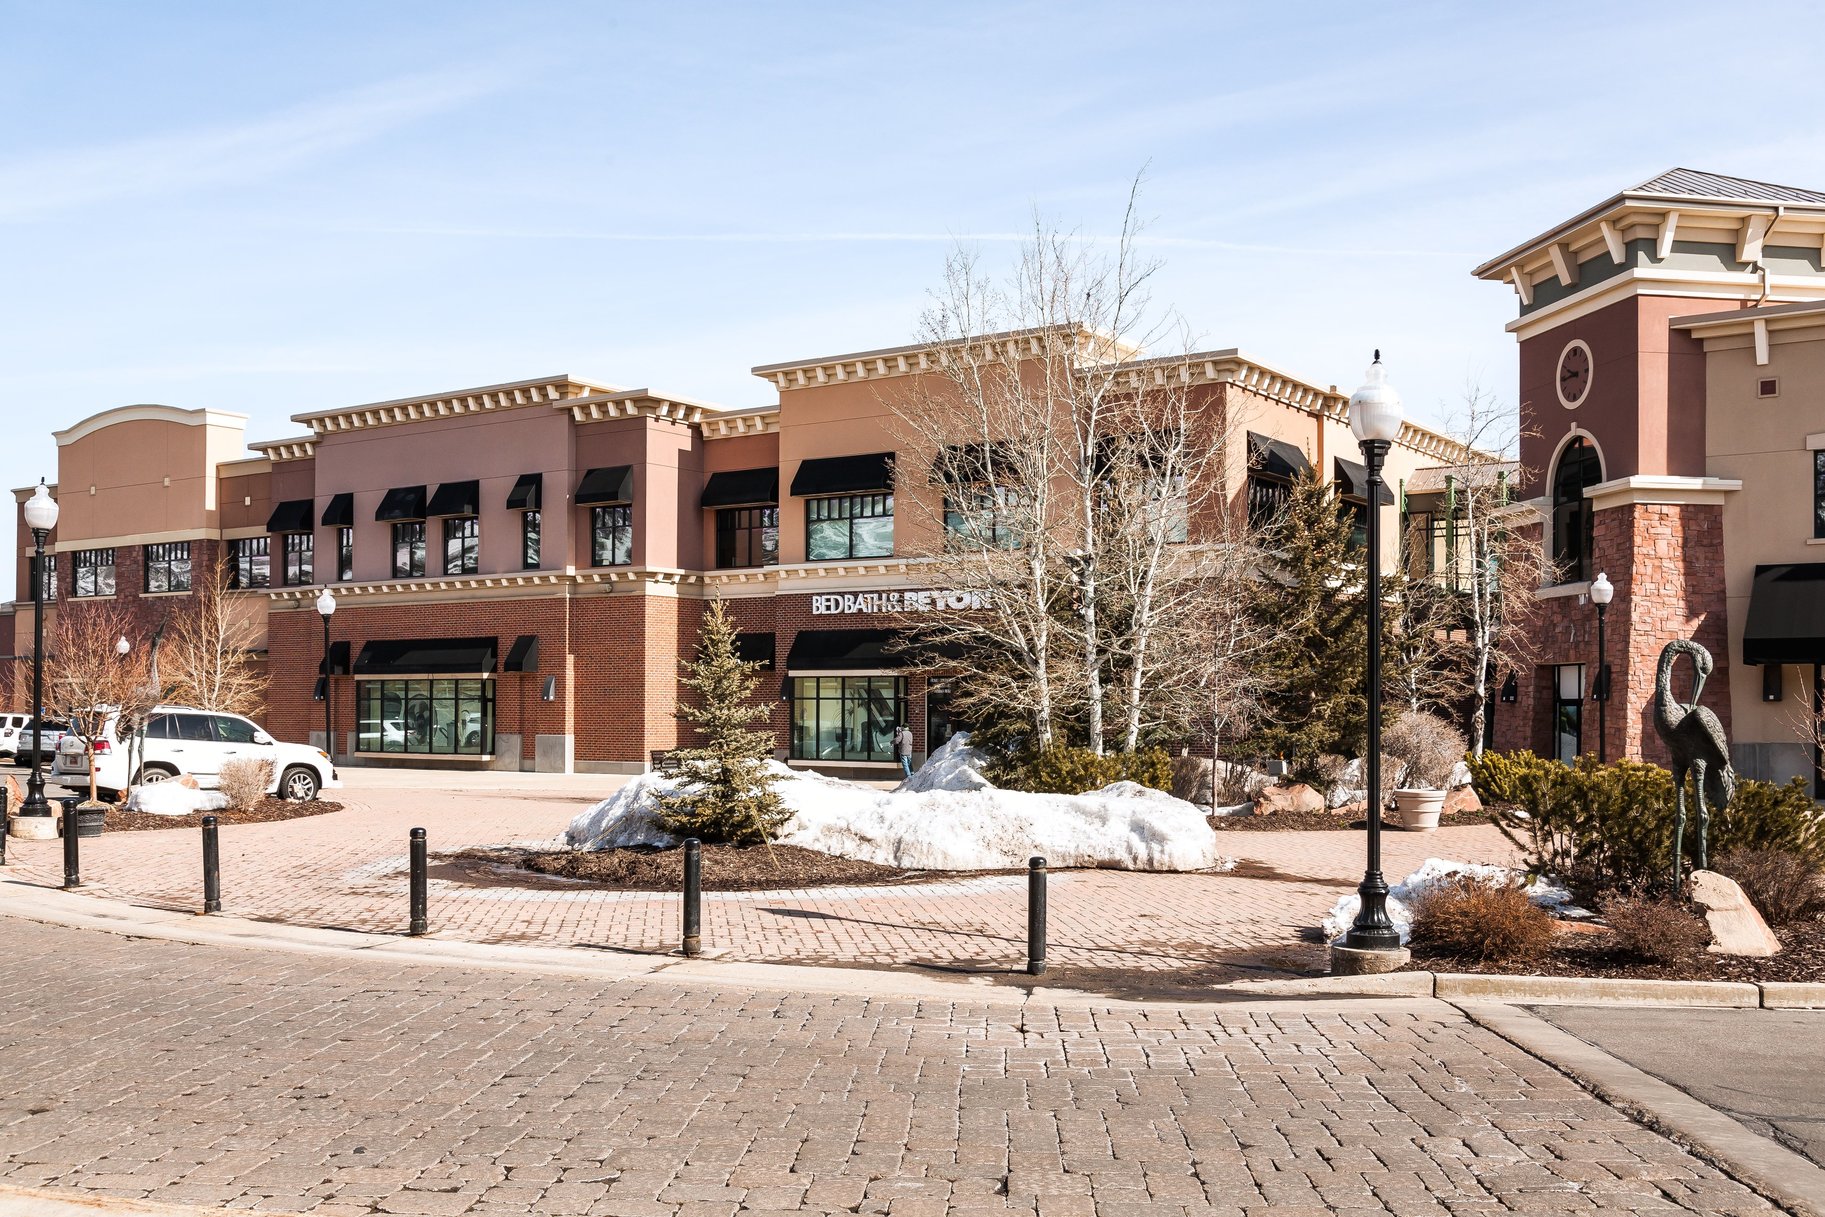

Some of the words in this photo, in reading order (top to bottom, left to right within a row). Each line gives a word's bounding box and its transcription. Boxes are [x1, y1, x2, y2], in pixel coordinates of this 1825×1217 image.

[812, 595, 844, 614] BED
[844, 593, 887, 613] BATH
[887, 592, 902, 612] &
[903, 590, 999, 612] BEYON
